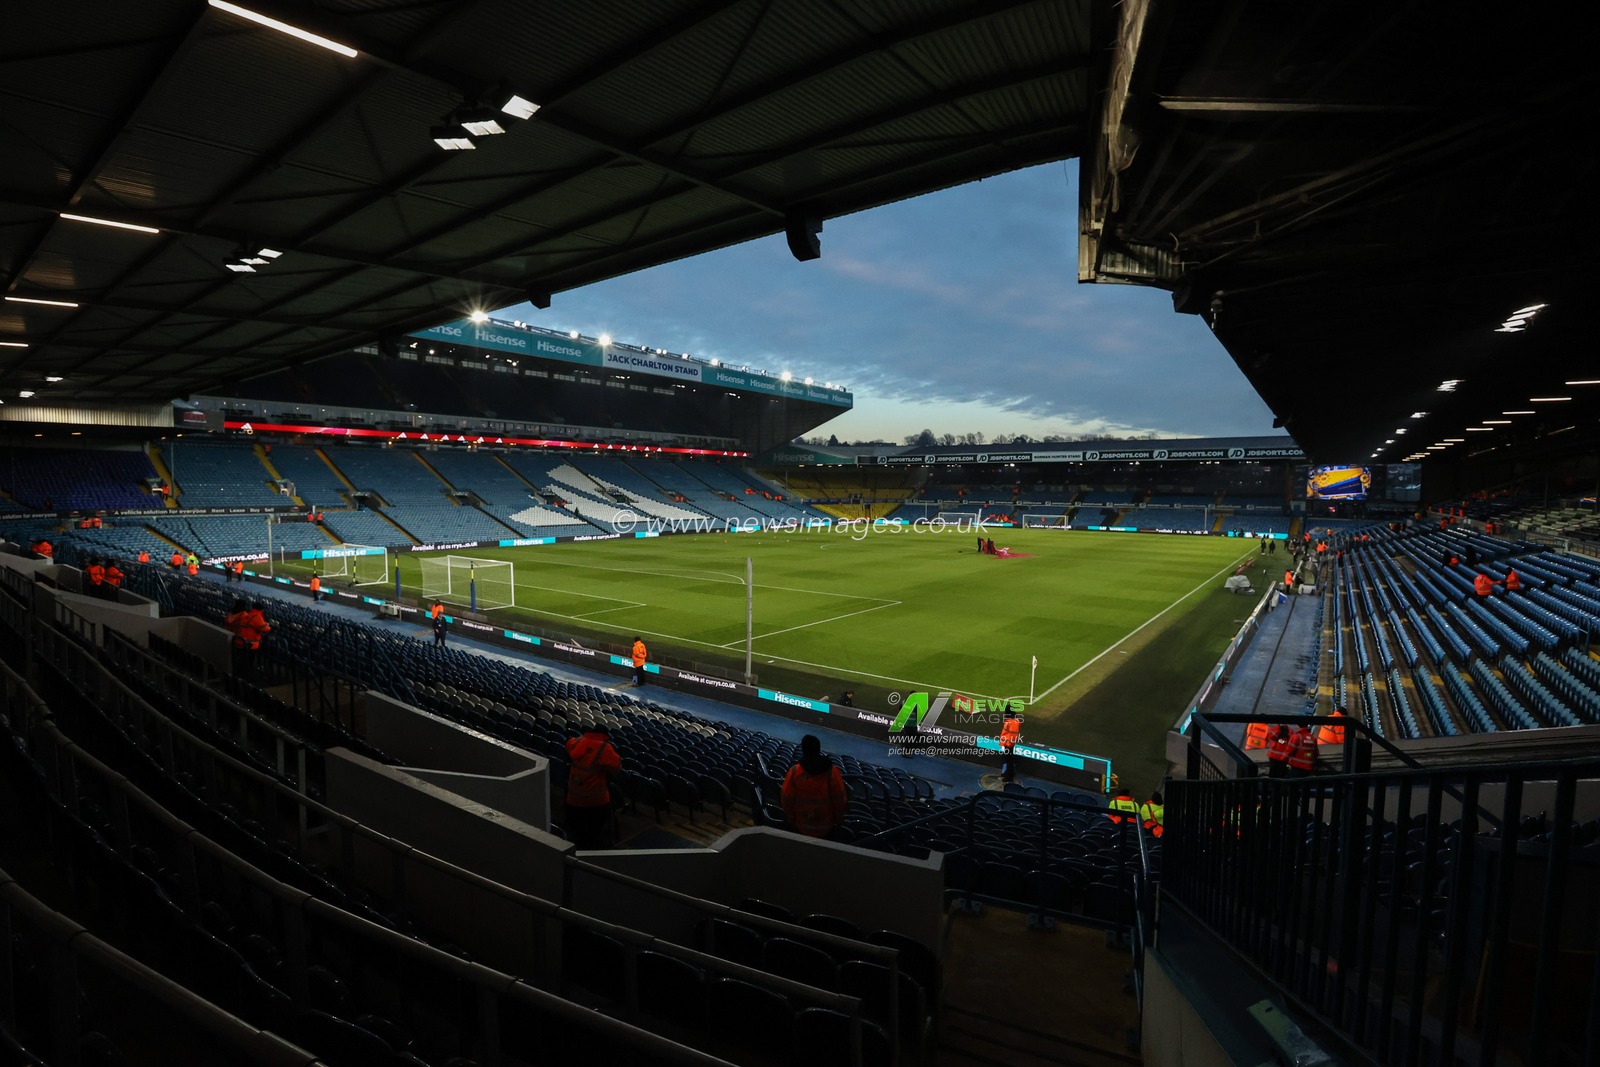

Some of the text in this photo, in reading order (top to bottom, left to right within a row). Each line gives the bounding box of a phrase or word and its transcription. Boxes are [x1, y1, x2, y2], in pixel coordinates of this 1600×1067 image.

[475, 330, 526, 348] Hisense
[537, 341, 582, 357] Hisense
[607, 354, 699, 376] JACK CHARLTON STAND
[716, 372, 745, 385] Hisense
[750, 379, 775, 391] Hisense
[773, 452, 815, 462] Hisense
[1100, 452, 1150, 460] JDSPORTS.COM
[1169, 450, 1224, 458] JDSPORTS.COM
[513, 538, 544, 546] Hisense
[323, 549, 367, 558] Hisense
[678, 671, 699, 682] Available
[705, 677, 737, 690] currys.co.uk
[774, 692, 812, 709] Hisense
[857, 711, 889, 725] Available
